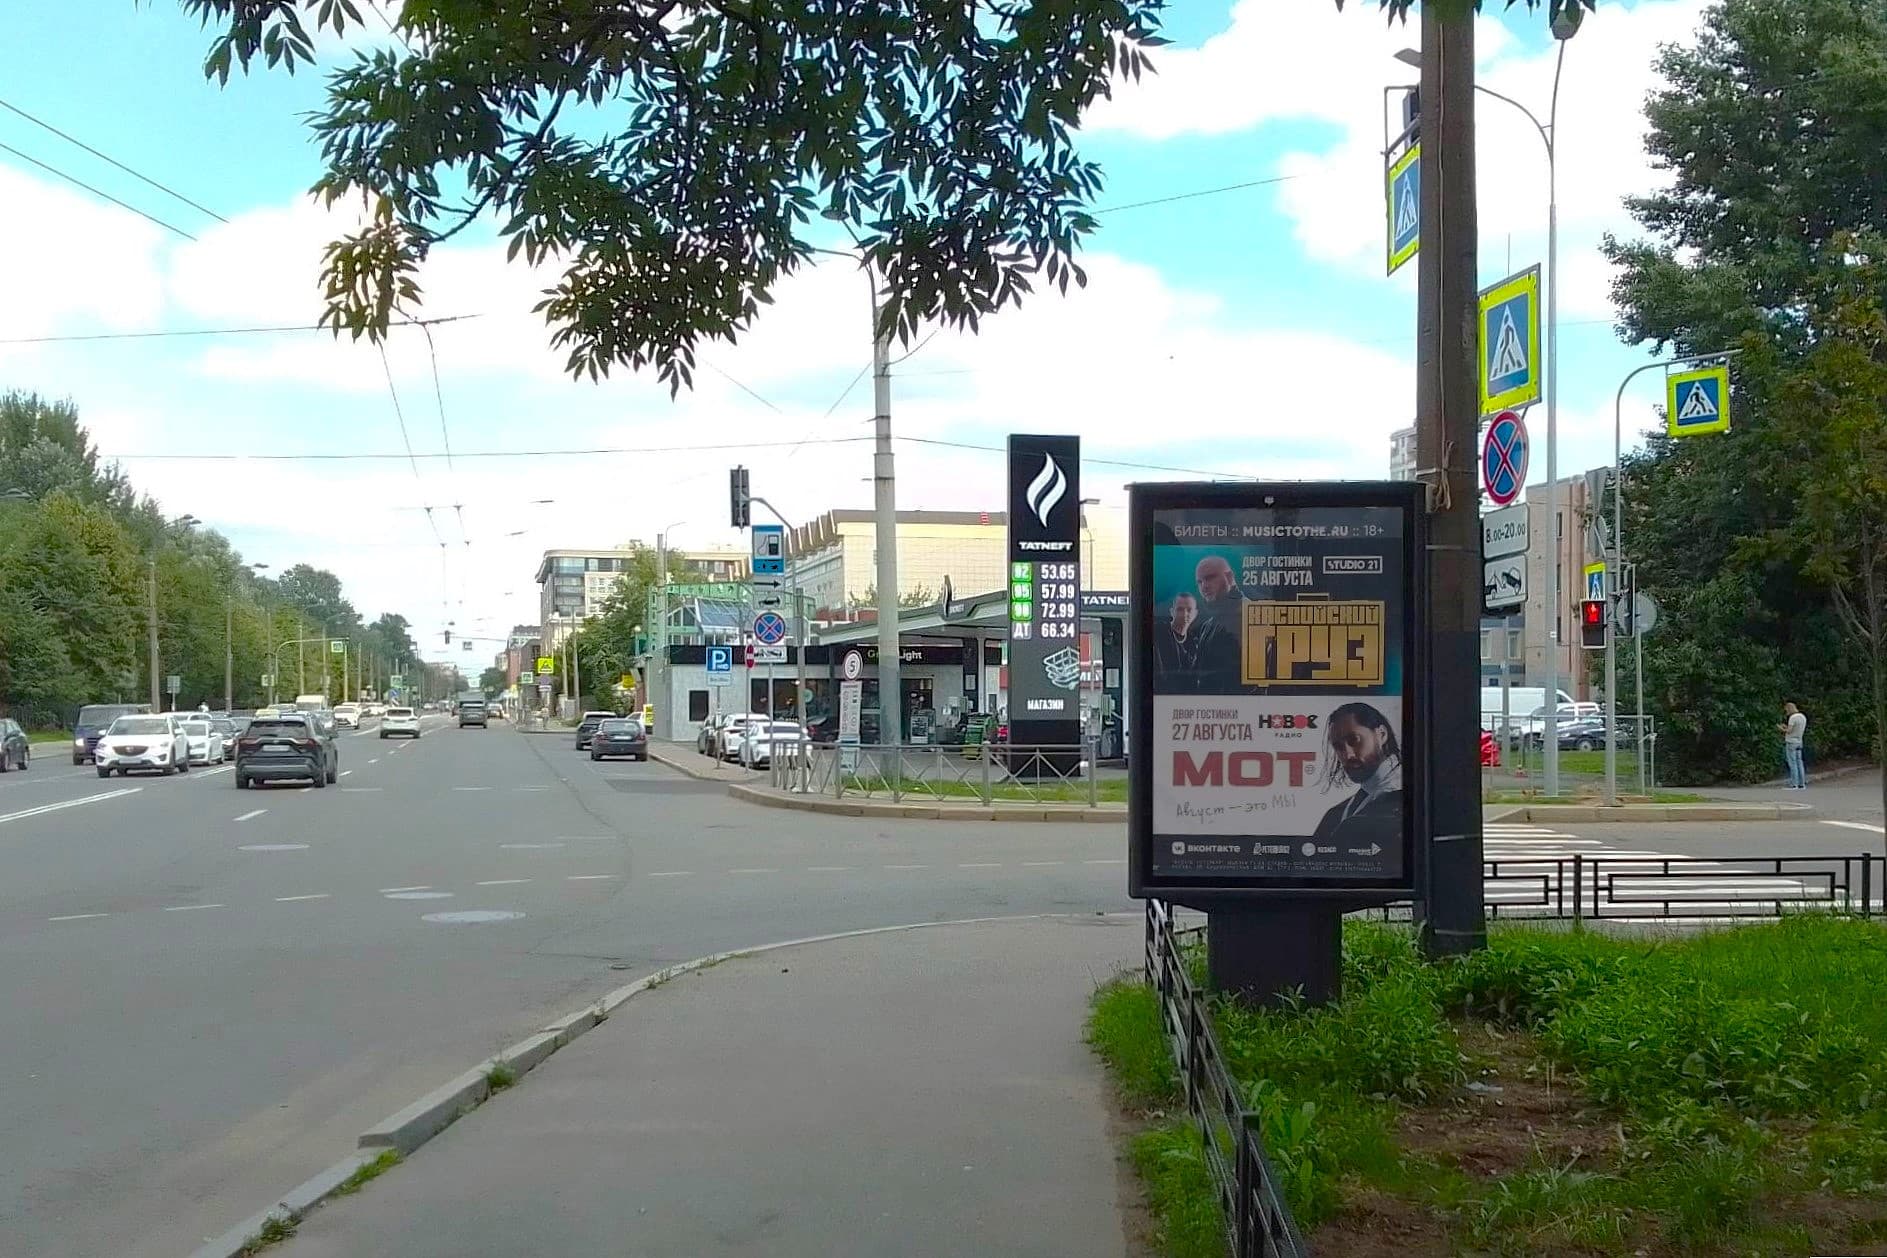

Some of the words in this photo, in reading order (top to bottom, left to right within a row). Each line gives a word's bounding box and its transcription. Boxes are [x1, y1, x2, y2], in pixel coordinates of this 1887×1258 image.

[1174, 525, 1228, 537] БИЛЕТЫ
[1242, 525, 1349, 537] MUSICTOTHE.RU
[1363, 525, 1385, 537] 18+
[1018, 542, 1073, 550] TATNEFT
[1242, 556, 1266, 568] ДВОР
[1268, 556, 1312, 568] ГОСТИНКИ
[1327, 560, 1365, 570] STUDIO
[1368, 560, 1378, 570] 21
[1041, 564, 1074, 580] 53.65
[1242, 570, 1258, 586] 25
[1260, 570, 1313, 586] АВГУСТА
[1041, 584, 1074, 599] 57.99
[1042, 603, 1074, 618] 72.99
[1013, 622, 1030, 638] ДТ
[1041, 622, 1074, 638] 66.34
[1248, 625, 1379, 680] ГРУЗ
[848, 660, 856, 672] 5
[1027, 699, 1064, 710] МАГАЗИН
[1172, 708, 1195, 720] ДВОР
[1196, 708, 1238, 719] ГОСТИНКИ
[1172, 724, 1190, 740] 27
[1192, 724, 1252, 740] АВГУСТА
[1172, 751, 1316, 787] МОТ
